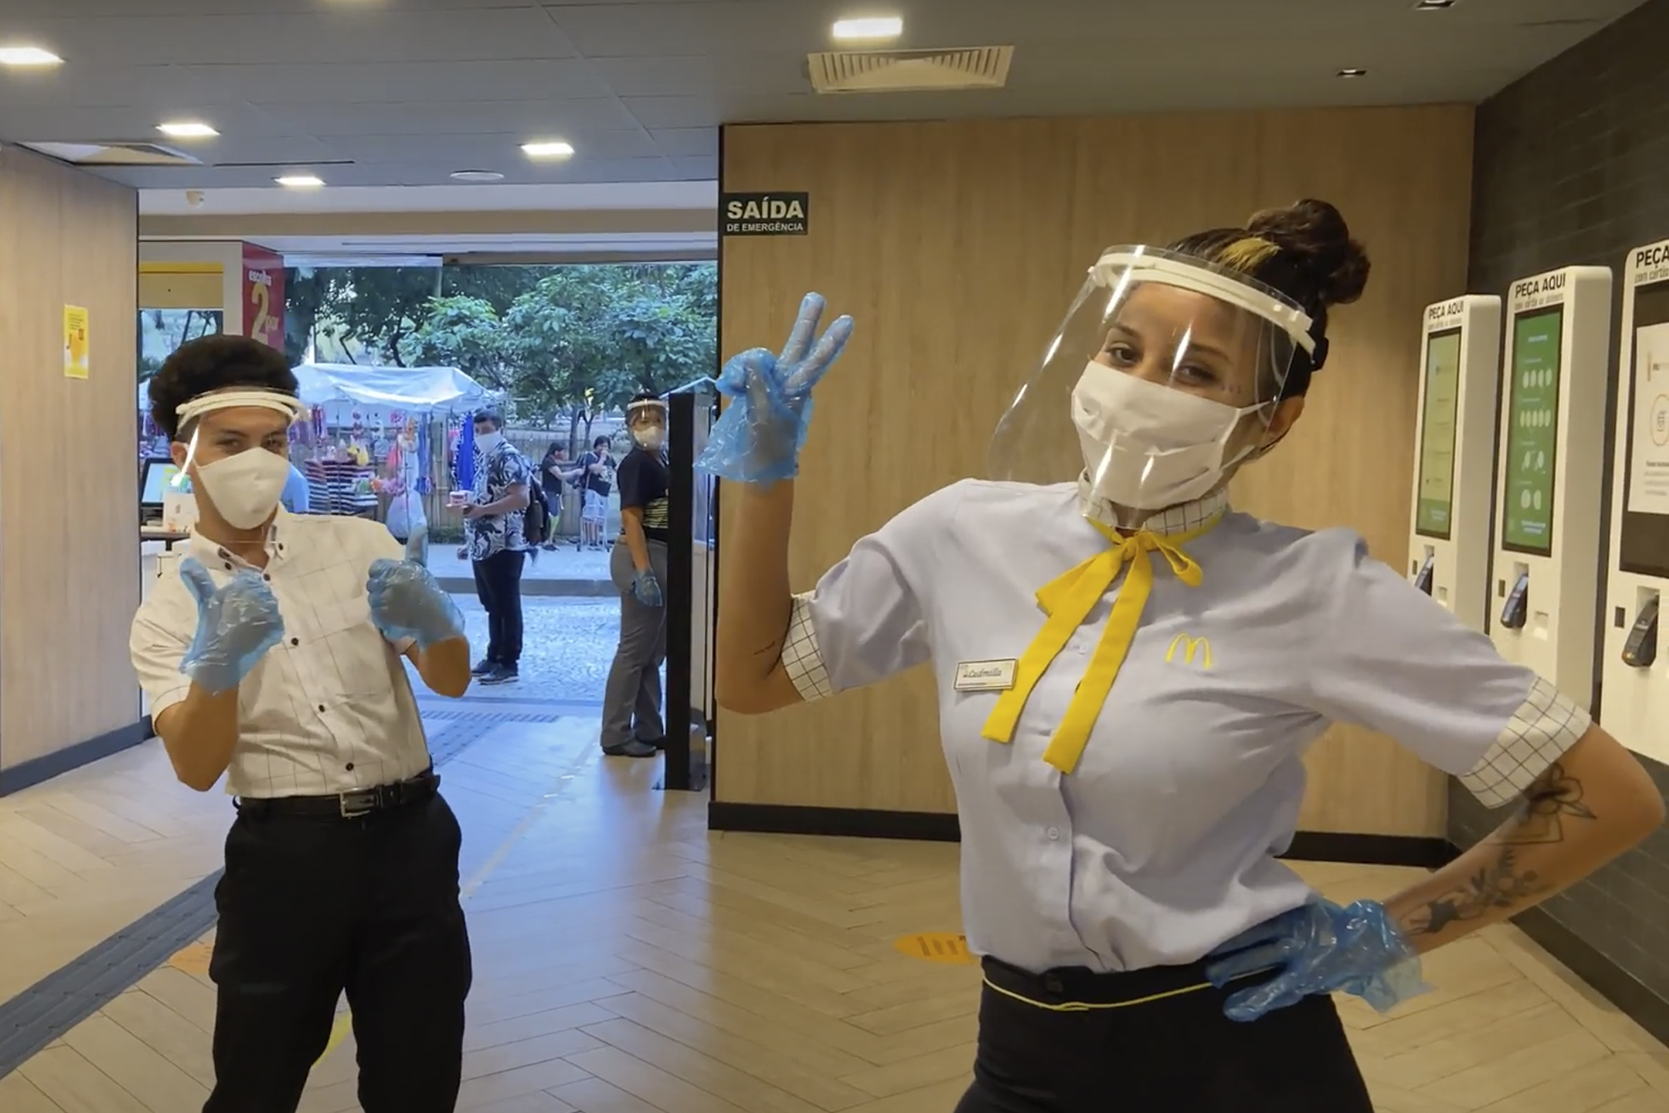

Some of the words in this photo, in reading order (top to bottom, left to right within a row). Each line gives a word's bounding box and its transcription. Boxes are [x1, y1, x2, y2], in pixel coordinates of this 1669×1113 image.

[727, 196, 804, 219] SAÍDA
[726, 223, 740, 232] DE
[742, 222, 804, 232] EMERGÊNCIA
[1636, 245, 1669, 269] PEÇA
[1515, 281, 1540, 299] PEÇA
[1542, 272, 1566, 292] AQUI
[251, 282, 269, 345] 2
[1429, 306, 1445, 320] PEÇA
[1447, 300, 1464, 316] AQUI
